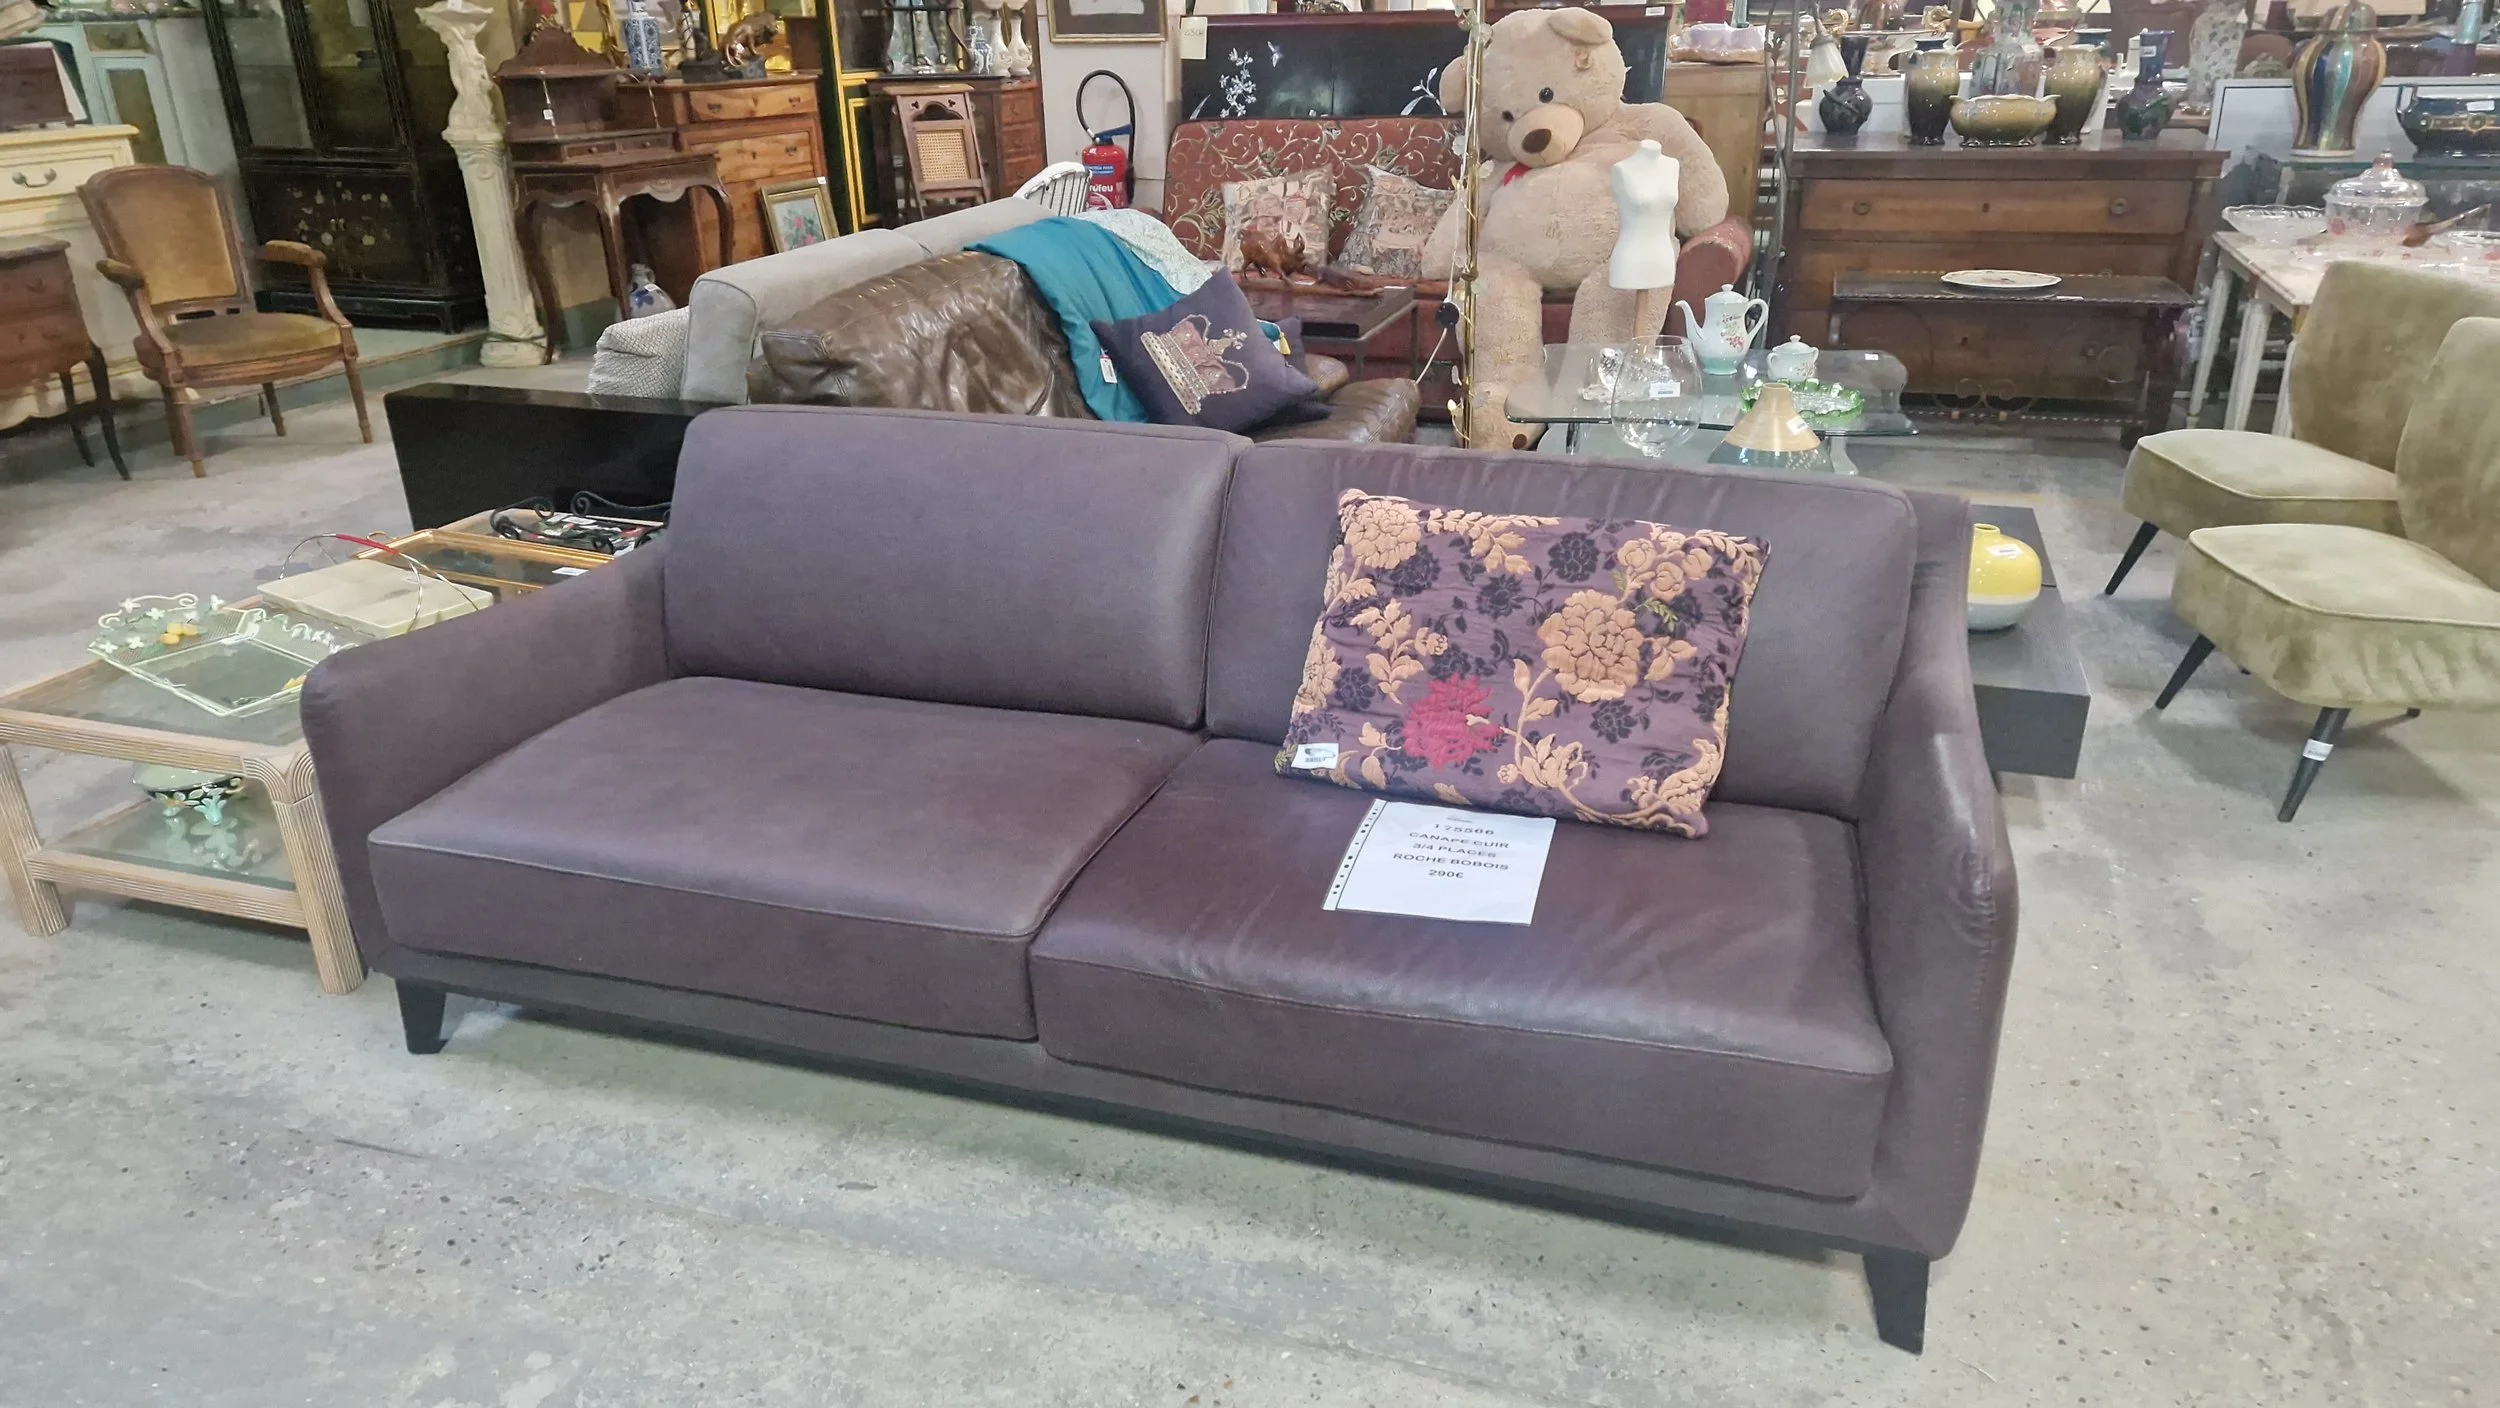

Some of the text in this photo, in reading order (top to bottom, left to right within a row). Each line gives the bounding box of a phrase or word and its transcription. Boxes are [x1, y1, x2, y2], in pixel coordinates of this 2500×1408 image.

[1408, 831, 1510, 849] CANAPE CUIR
[1412, 842, 1497, 858] 3/4 PLACES
[1392, 853, 1509, 871] ROCHE BOBOIS
[1428, 868, 1465, 879] 290€
